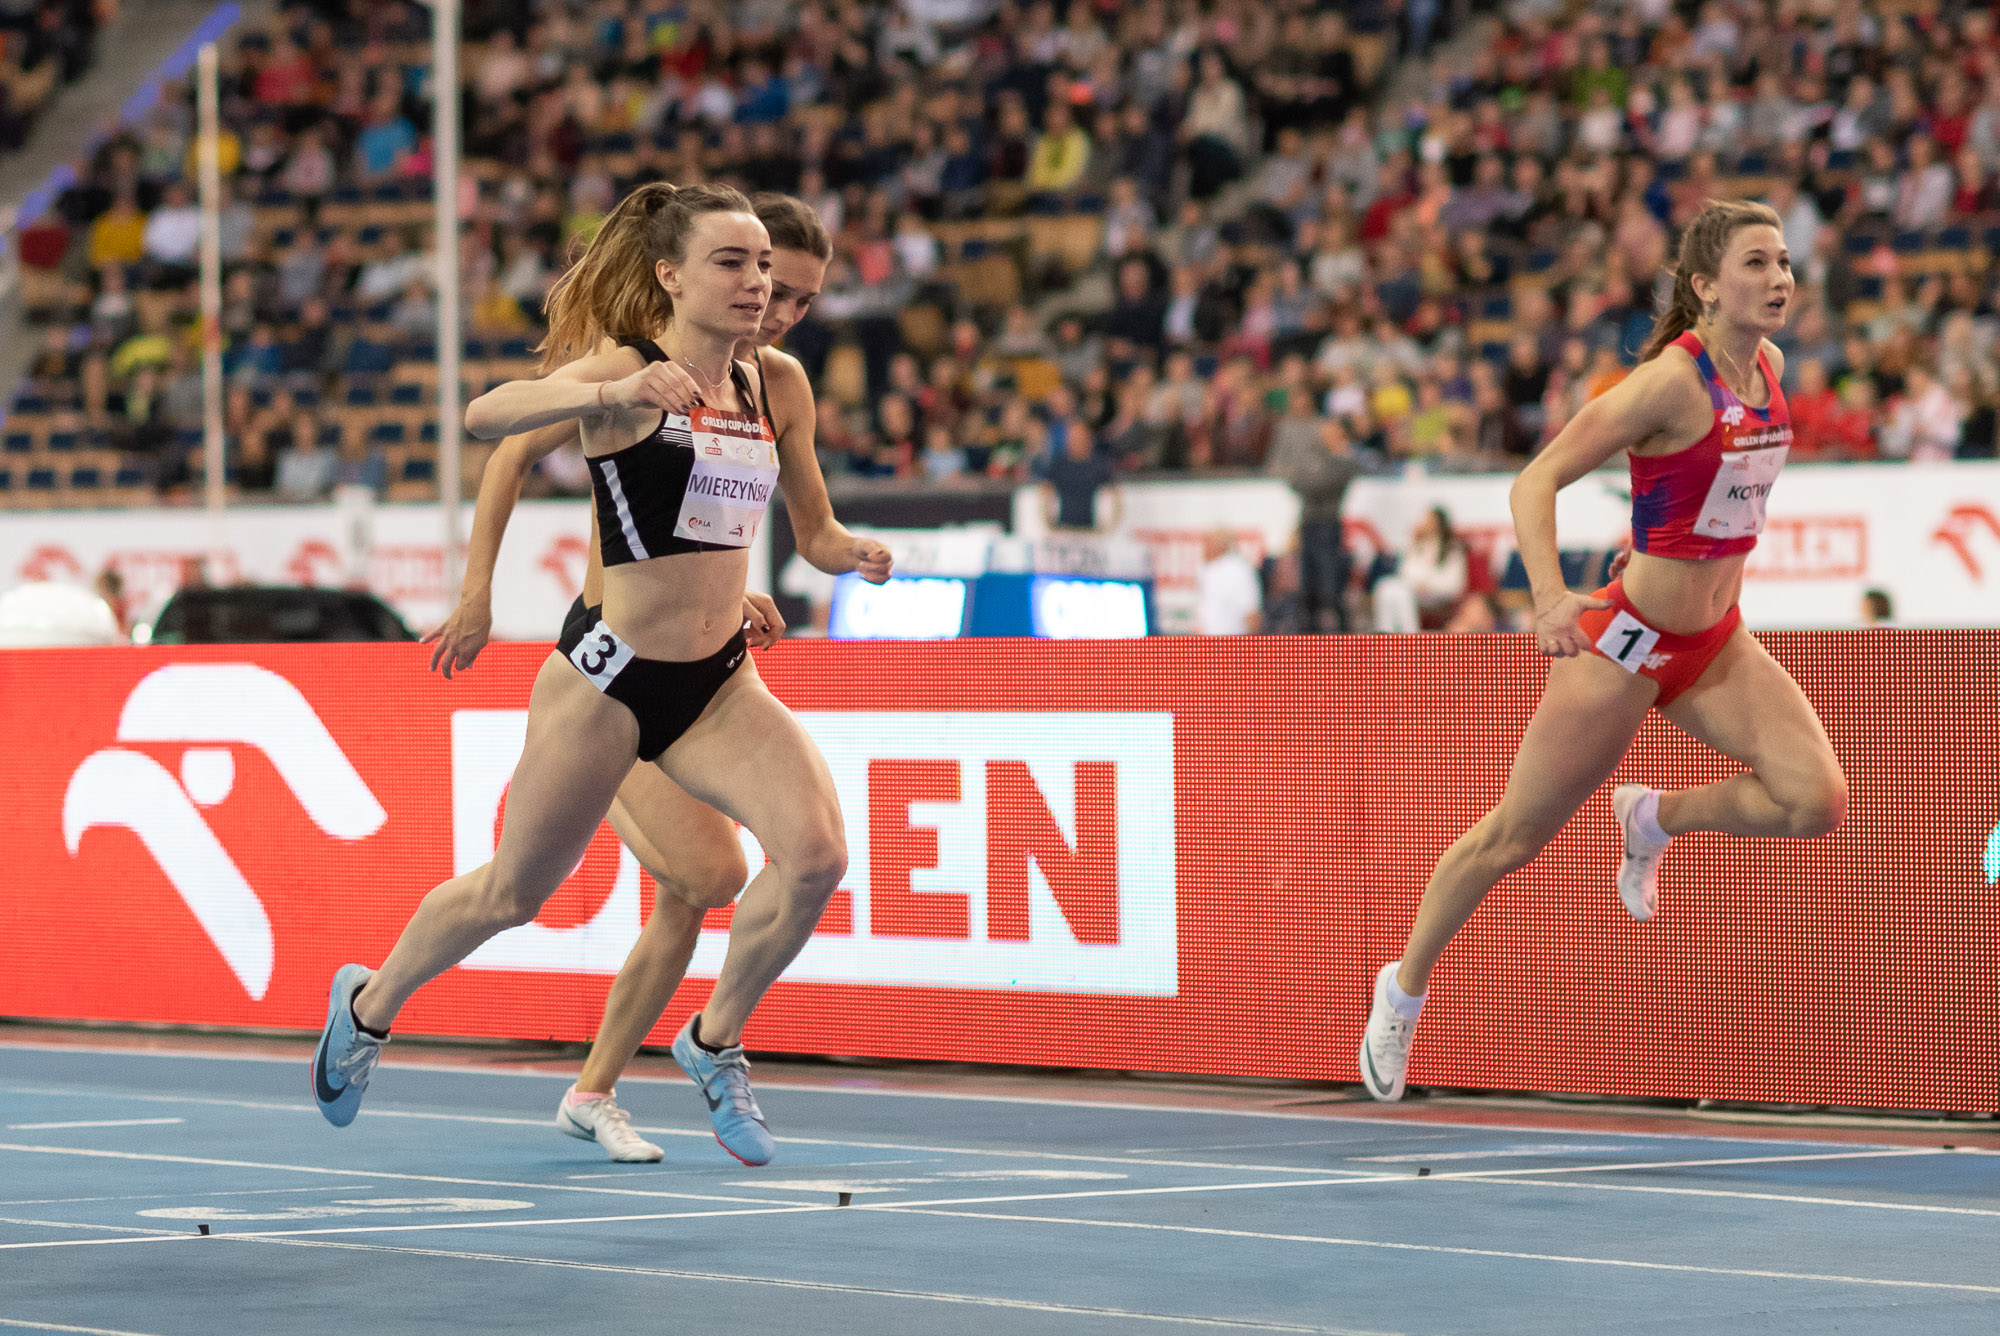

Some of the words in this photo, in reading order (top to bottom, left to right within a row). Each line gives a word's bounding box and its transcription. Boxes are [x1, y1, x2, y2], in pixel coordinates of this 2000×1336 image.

[701, 415, 728, 429] ORLEN
[728, 419, 742, 431] CUP
[1721, 406, 1745, 426] 4F
[1733, 436, 1759, 447] ORLEN
[688, 473, 769, 503] MIERZYŃSKA
[581, 634, 617, 676] 3
[1617, 628, 1644, 662] 1
